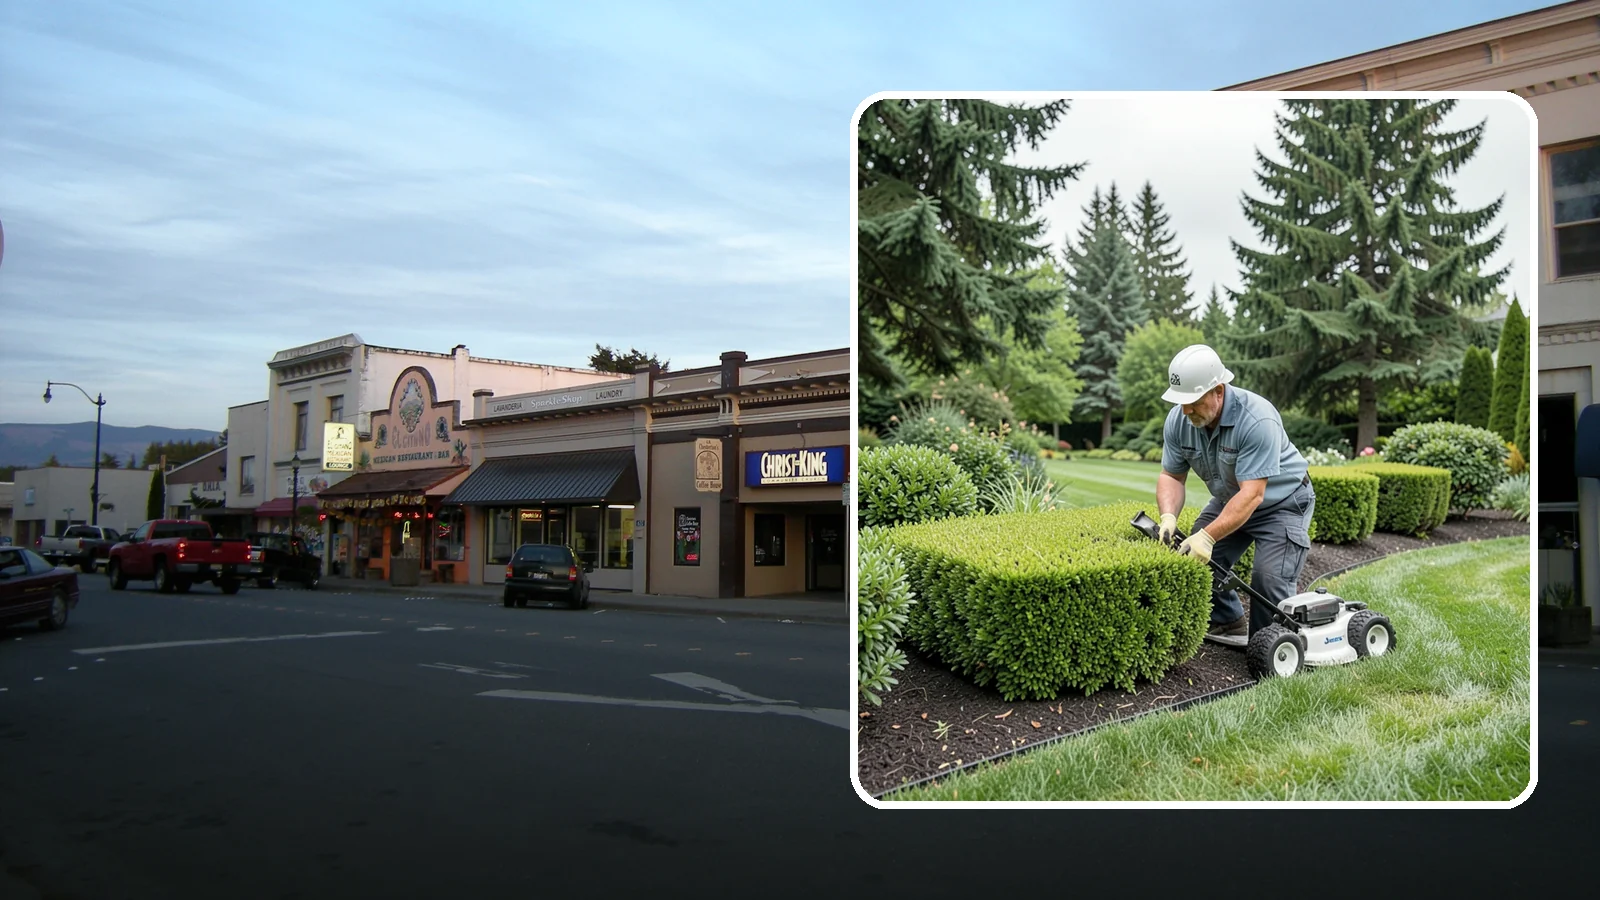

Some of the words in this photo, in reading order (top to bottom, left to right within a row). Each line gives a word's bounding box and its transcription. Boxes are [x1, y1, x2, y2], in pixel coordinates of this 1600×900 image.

[561, 394, 582, 406] Shop
[594, 388, 624, 400] LAUNDRY
[493, 401, 522, 413] LAVANDERIA
[373, 454, 397, 464] MEXICAN
[397, 451, 433, 462] RESTAURANT
[438, 449, 450, 459] BAR
[761, 452, 797, 477] CHRIST
[799, 449, 827, 476] KING
[696, 480, 709, 488] Coffee
[710, 480, 722, 488] House
